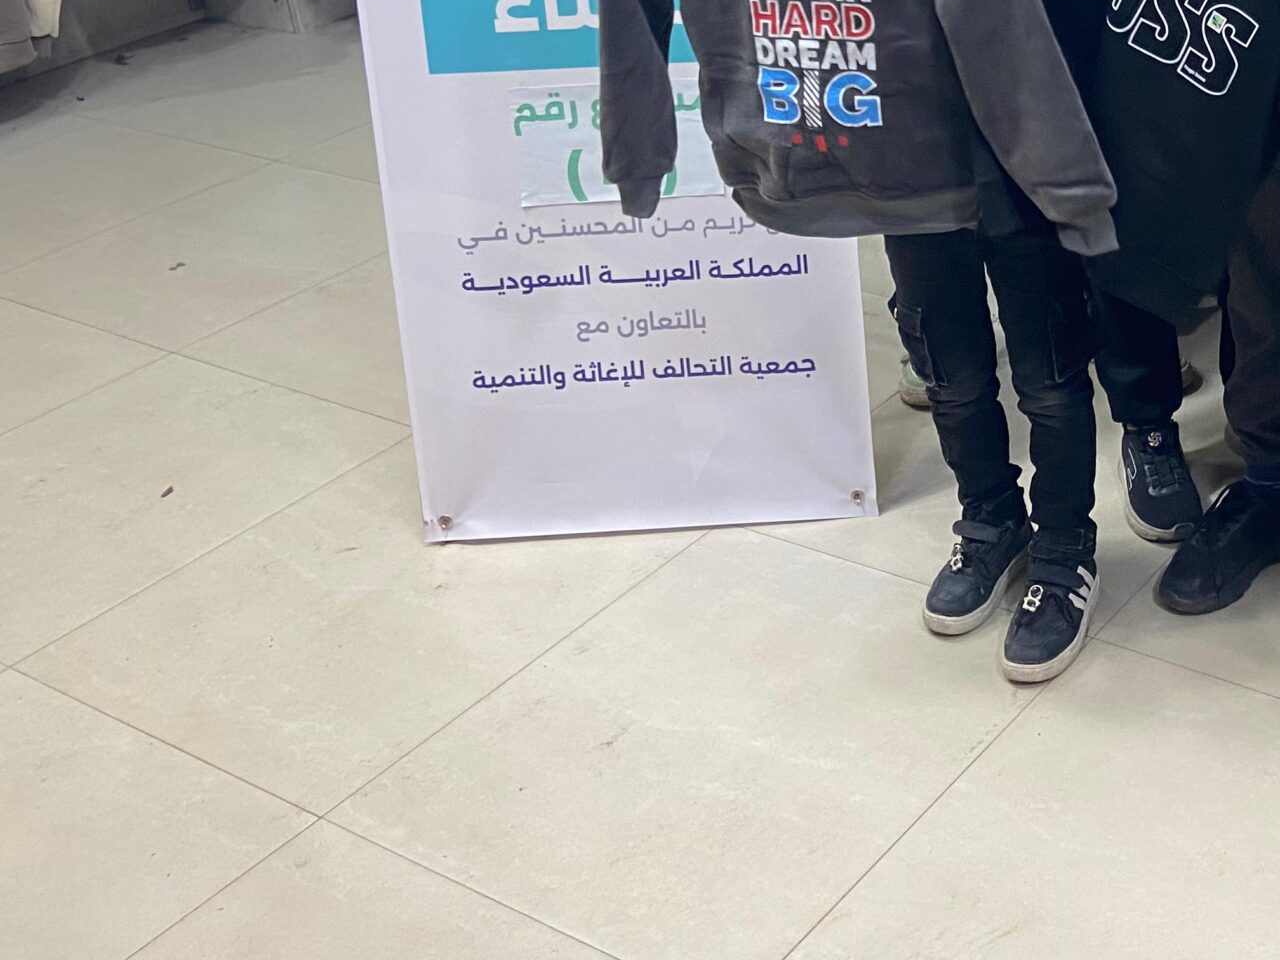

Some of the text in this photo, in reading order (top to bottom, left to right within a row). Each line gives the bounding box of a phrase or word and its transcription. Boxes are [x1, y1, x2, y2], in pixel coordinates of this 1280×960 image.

[754, 37, 877, 71] DREAM
[513, 91, 579, 137] رقم
[757, 65, 883, 128] BIG
[457, 220, 509, 256] في
[515, 217, 643, 246] المحسنين
[651, 217, 696, 239] من
[461, 253, 809, 296] المملكة العربية السعودية
[576, 308, 707, 343] بالتعاون مع
[472, 355, 817, 394] جمعية التحالف للإغاثة والتنمية
